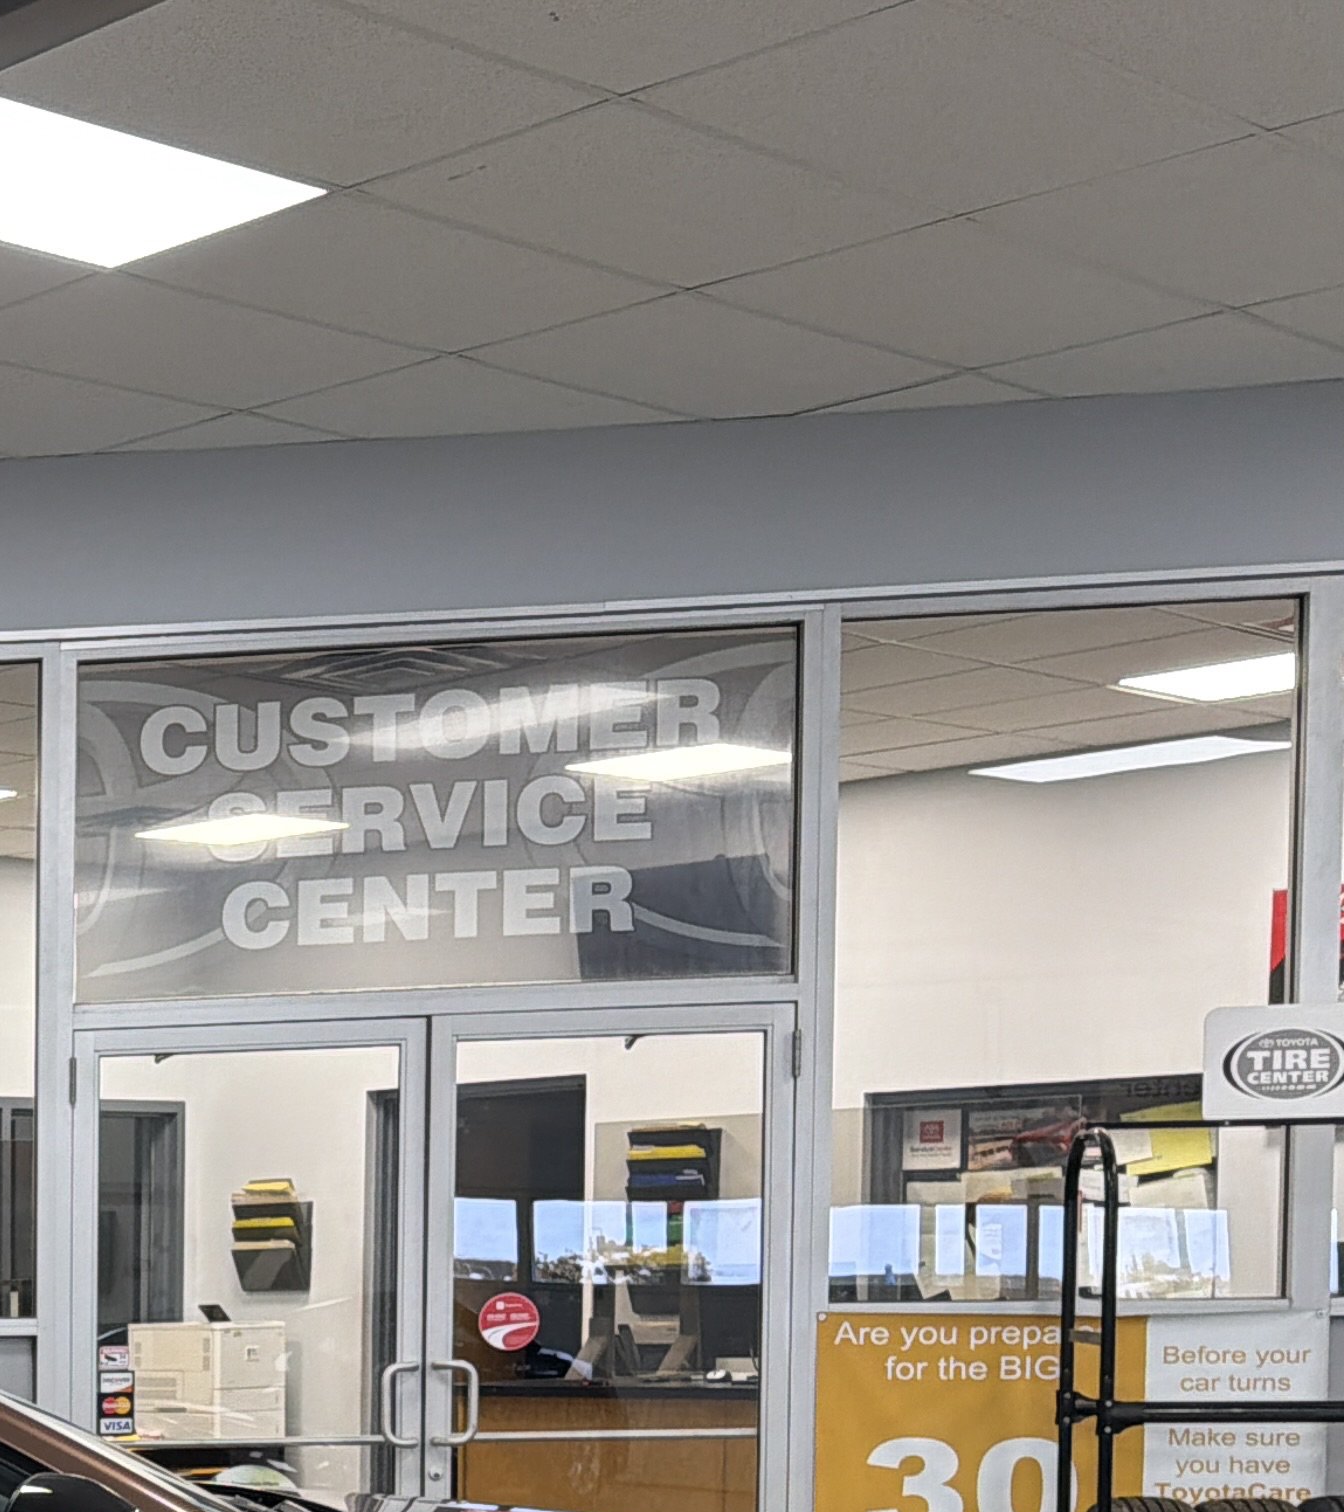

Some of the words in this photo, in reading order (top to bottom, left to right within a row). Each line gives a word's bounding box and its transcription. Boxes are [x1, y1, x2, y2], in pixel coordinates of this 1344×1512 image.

[139, 677, 721, 777] CUSTOMER
[207, 773, 652, 862] SERVICE
[221, 866, 634, 951] CENTER
[1276, 1038, 1318, 1048] TOYOTA
[1247, 1048, 1330, 1071] TIRE
[1247, 1070, 1329, 1084] CENTER
[834, 1321, 890, 1346] Are
[900, 1326, 958, 1351] you
[969, 1325, 1061, 1351] prepa
[885, 1355, 928, 1381] for
[937, 1355, 988, 1381] the
[999, 1355, 1060, 1381] BIG
[1163, 1345, 1247, 1365] Before
[1255, 1349, 1312, 1368] your
[1180, 1376, 1221, 1392] car
[1228, 1374, 1292, 1392] turns
[103, 1421, 131, 1431] VISA
[1168, 1428, 1236, 1447] Make
[1245, 1431, 1301, 1447] sure
[1175, 1459, 1220, 1478] you
[1229, 1455, 1291, 1474] have
[1154, 1482, 1312, 1503] ToyotaCare
